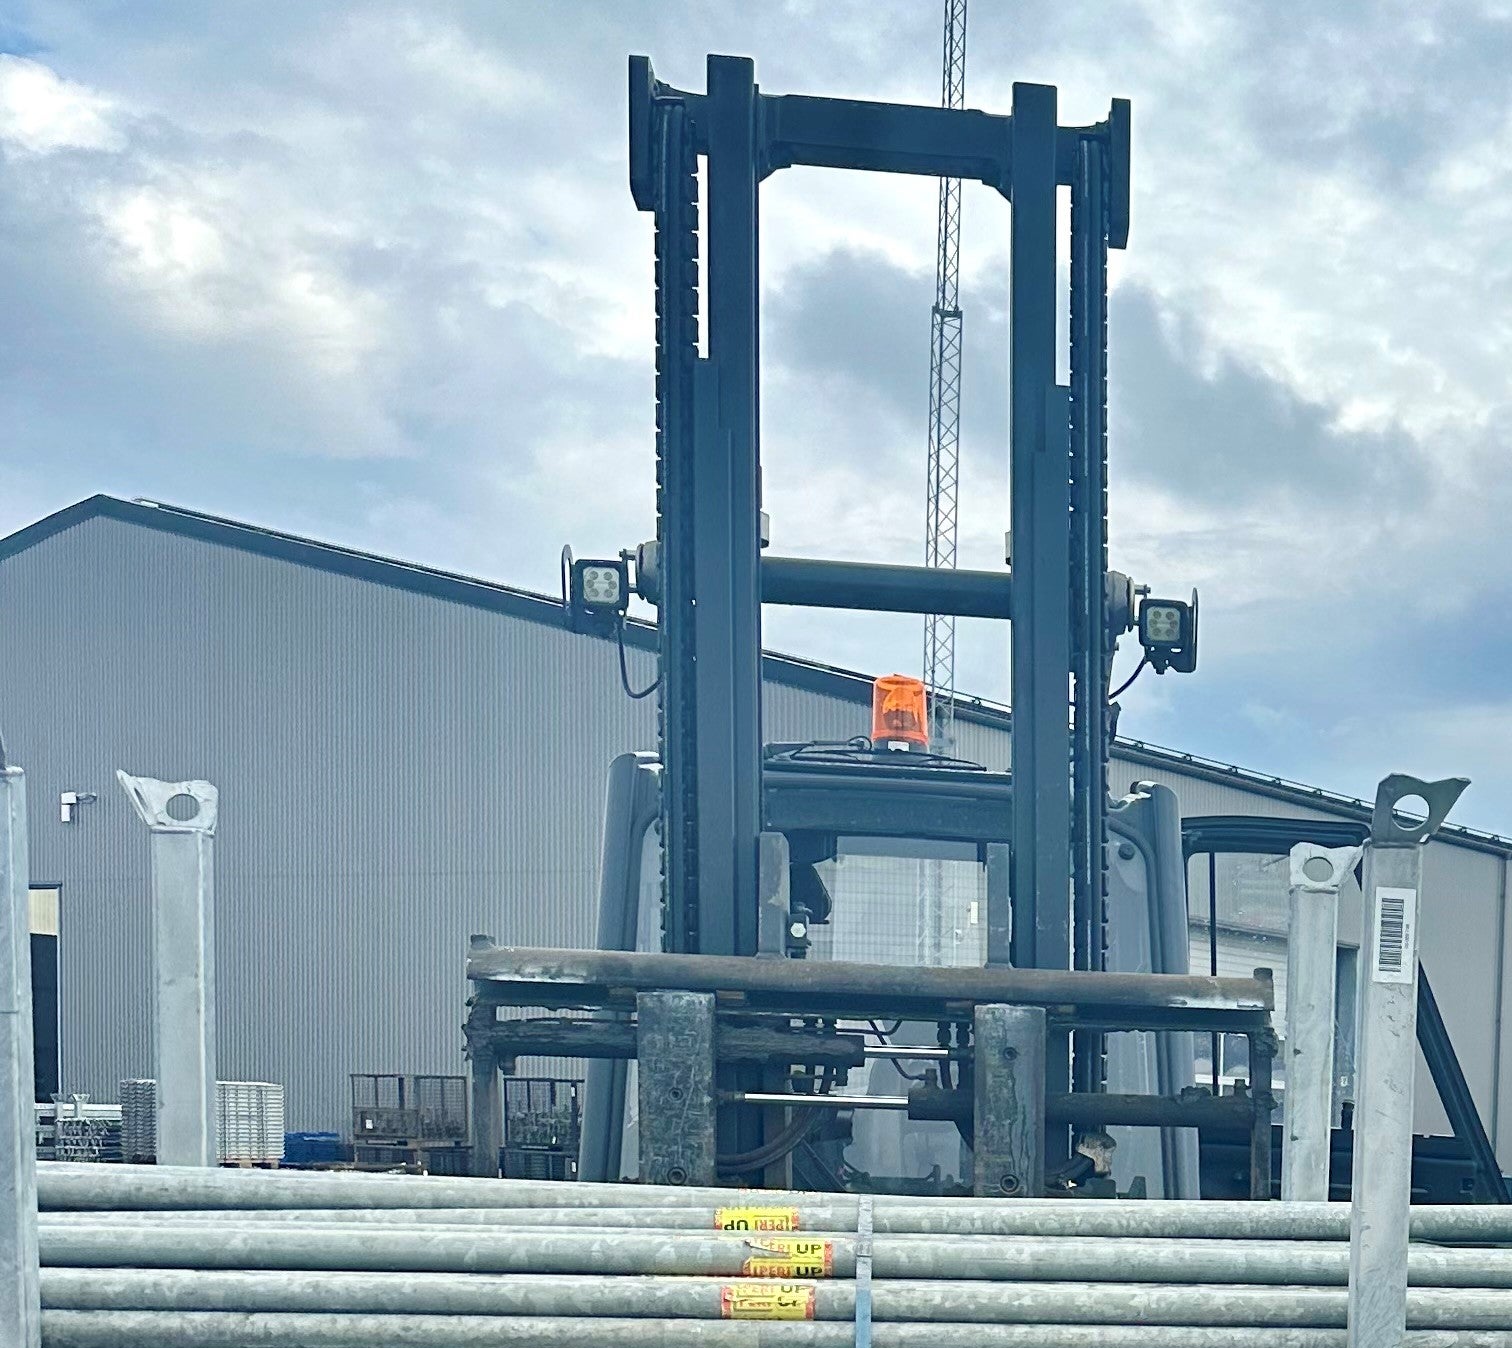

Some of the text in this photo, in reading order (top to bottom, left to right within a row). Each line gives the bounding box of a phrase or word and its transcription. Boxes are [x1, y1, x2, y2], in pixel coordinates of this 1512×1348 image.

[724, 1219, 749, 1231] UP
[796, 1243, 821, 1254] UP
[796, 1266, 822, 1278] UP
